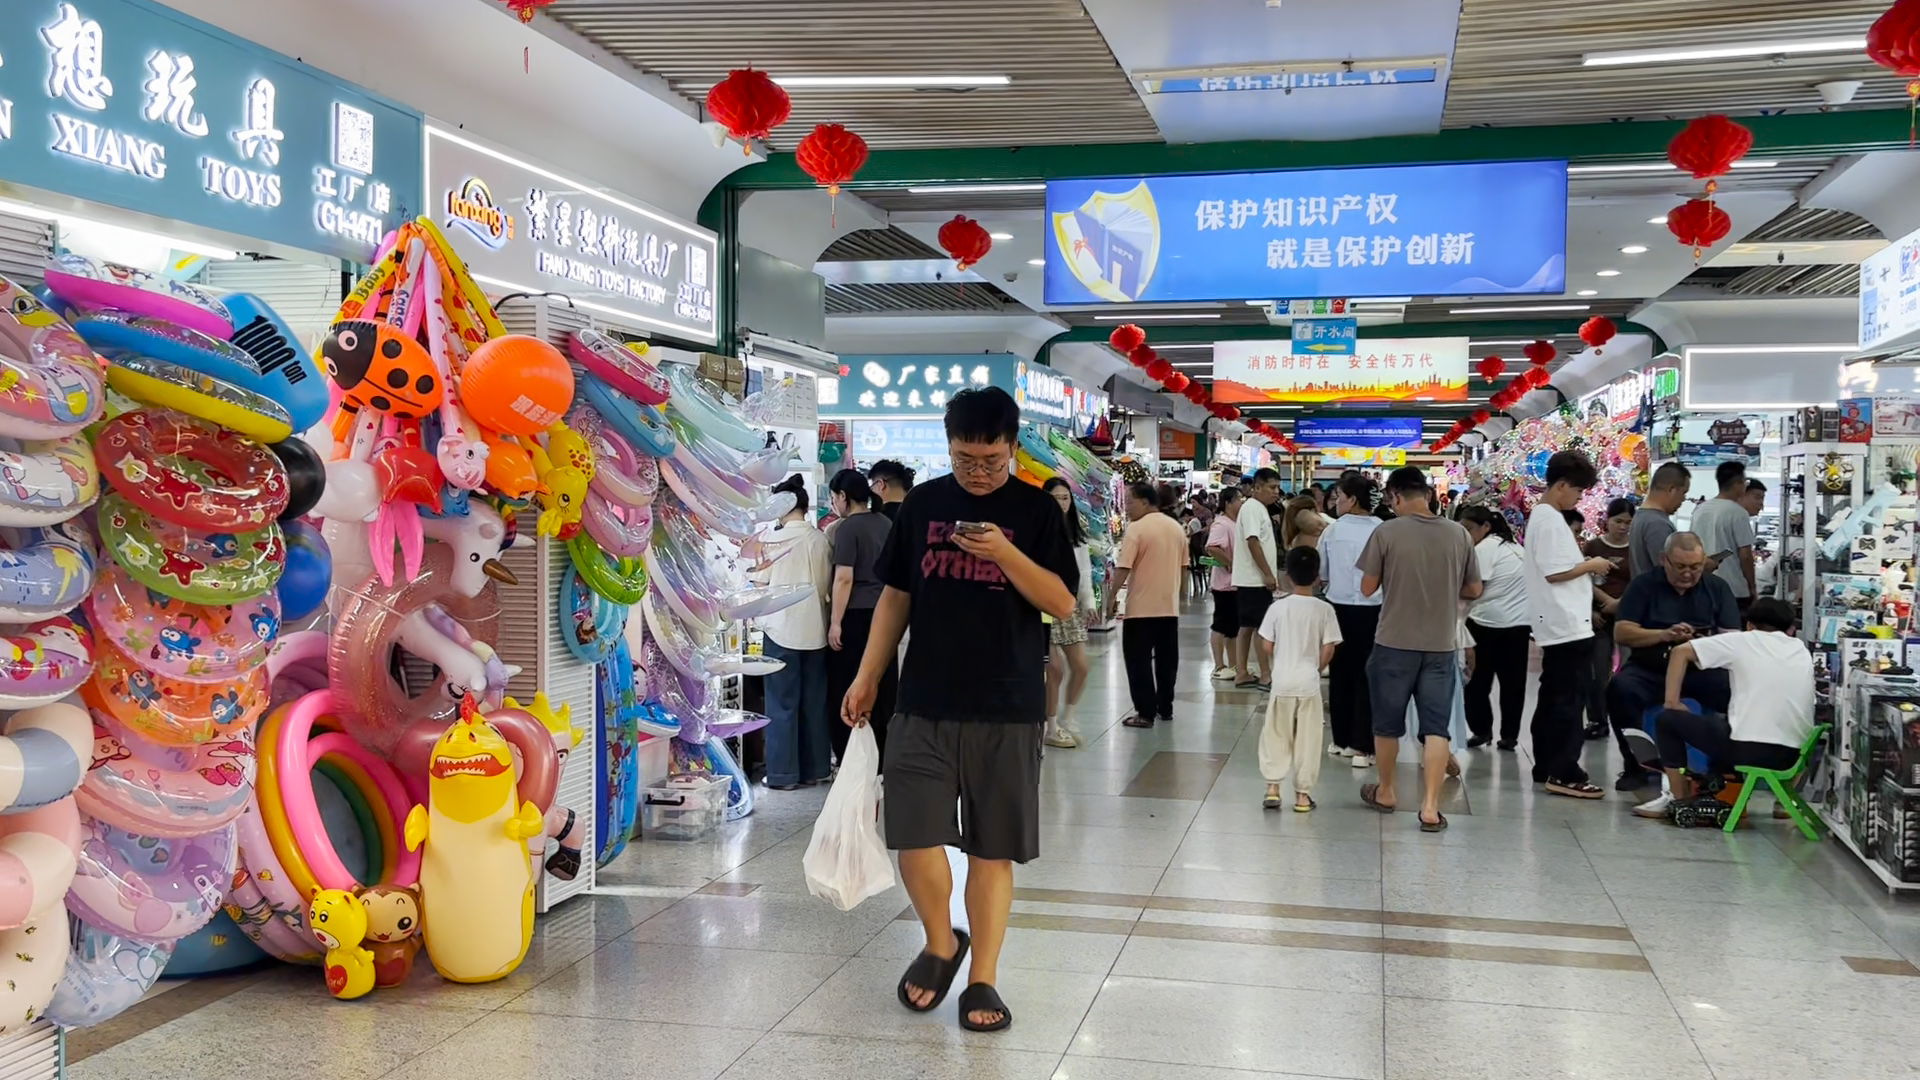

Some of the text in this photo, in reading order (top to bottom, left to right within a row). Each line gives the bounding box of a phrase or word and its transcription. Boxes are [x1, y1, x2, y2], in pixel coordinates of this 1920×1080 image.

[0, 3, 285, 166] 想玩具
[52, 113, 166, 179] XIANG
[201, 157, 281, 207] TOYS
[315, 167, 390, 213] 工厂店
[1195, 192, 1399, 231] 保护知识产权
[1266, 231, 1475, 271] 就是保护创新
[355, 266, 386, 301] Baby
[542, 252, 667, 305] FAN XING TOYS FACTORY
[1314, 326, 1354, 338] 开水间
[281, 360, 307, 385] ton
[1248, 353, 1434, 370] 消防时时在 安全传万代
